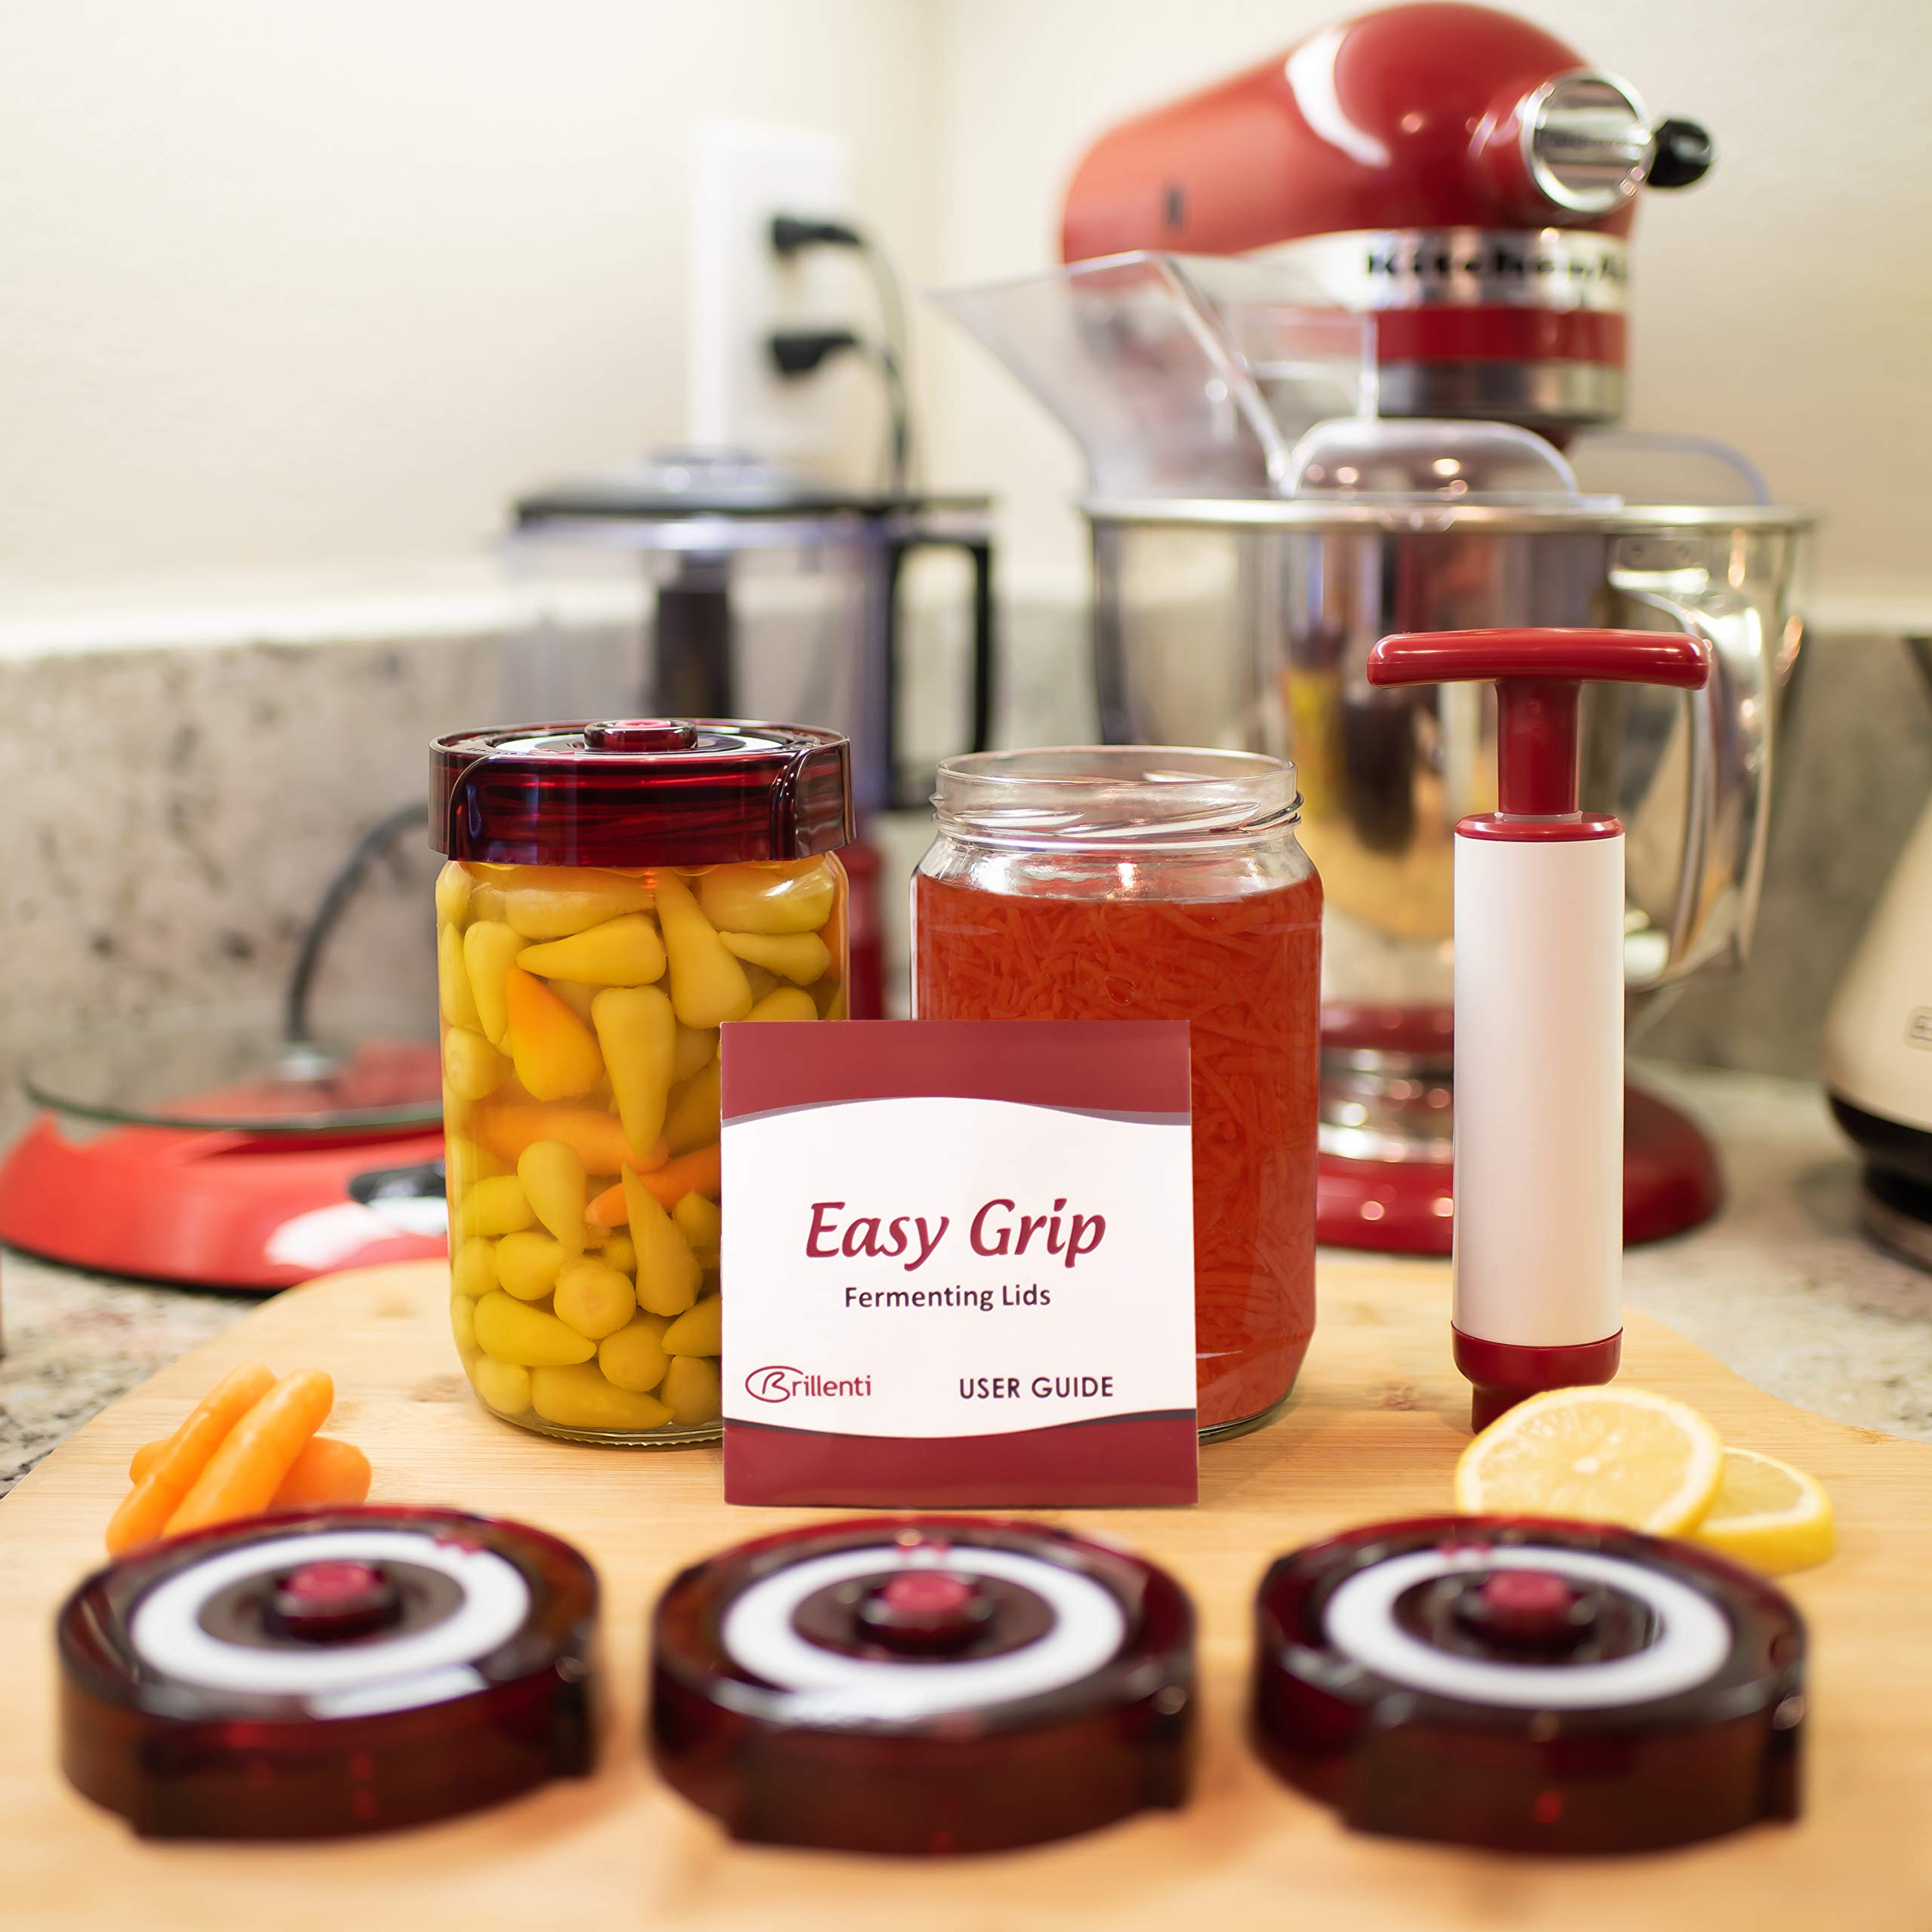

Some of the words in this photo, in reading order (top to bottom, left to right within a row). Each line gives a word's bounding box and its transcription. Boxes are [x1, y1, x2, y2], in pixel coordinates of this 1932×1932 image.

[805, 1201, 950, 1272] Easy
[969, 1198, 1106, 1269] Grip
[845, 1284, 994, 1312] Fermenting
[1002, 1283, 1051, 1306] Lids
[744, 1365, 872, 1404] Brillenti
[959, 1377, 1020, 1400] USER
[1031, 1376, 1113, 1398] GUIDE
